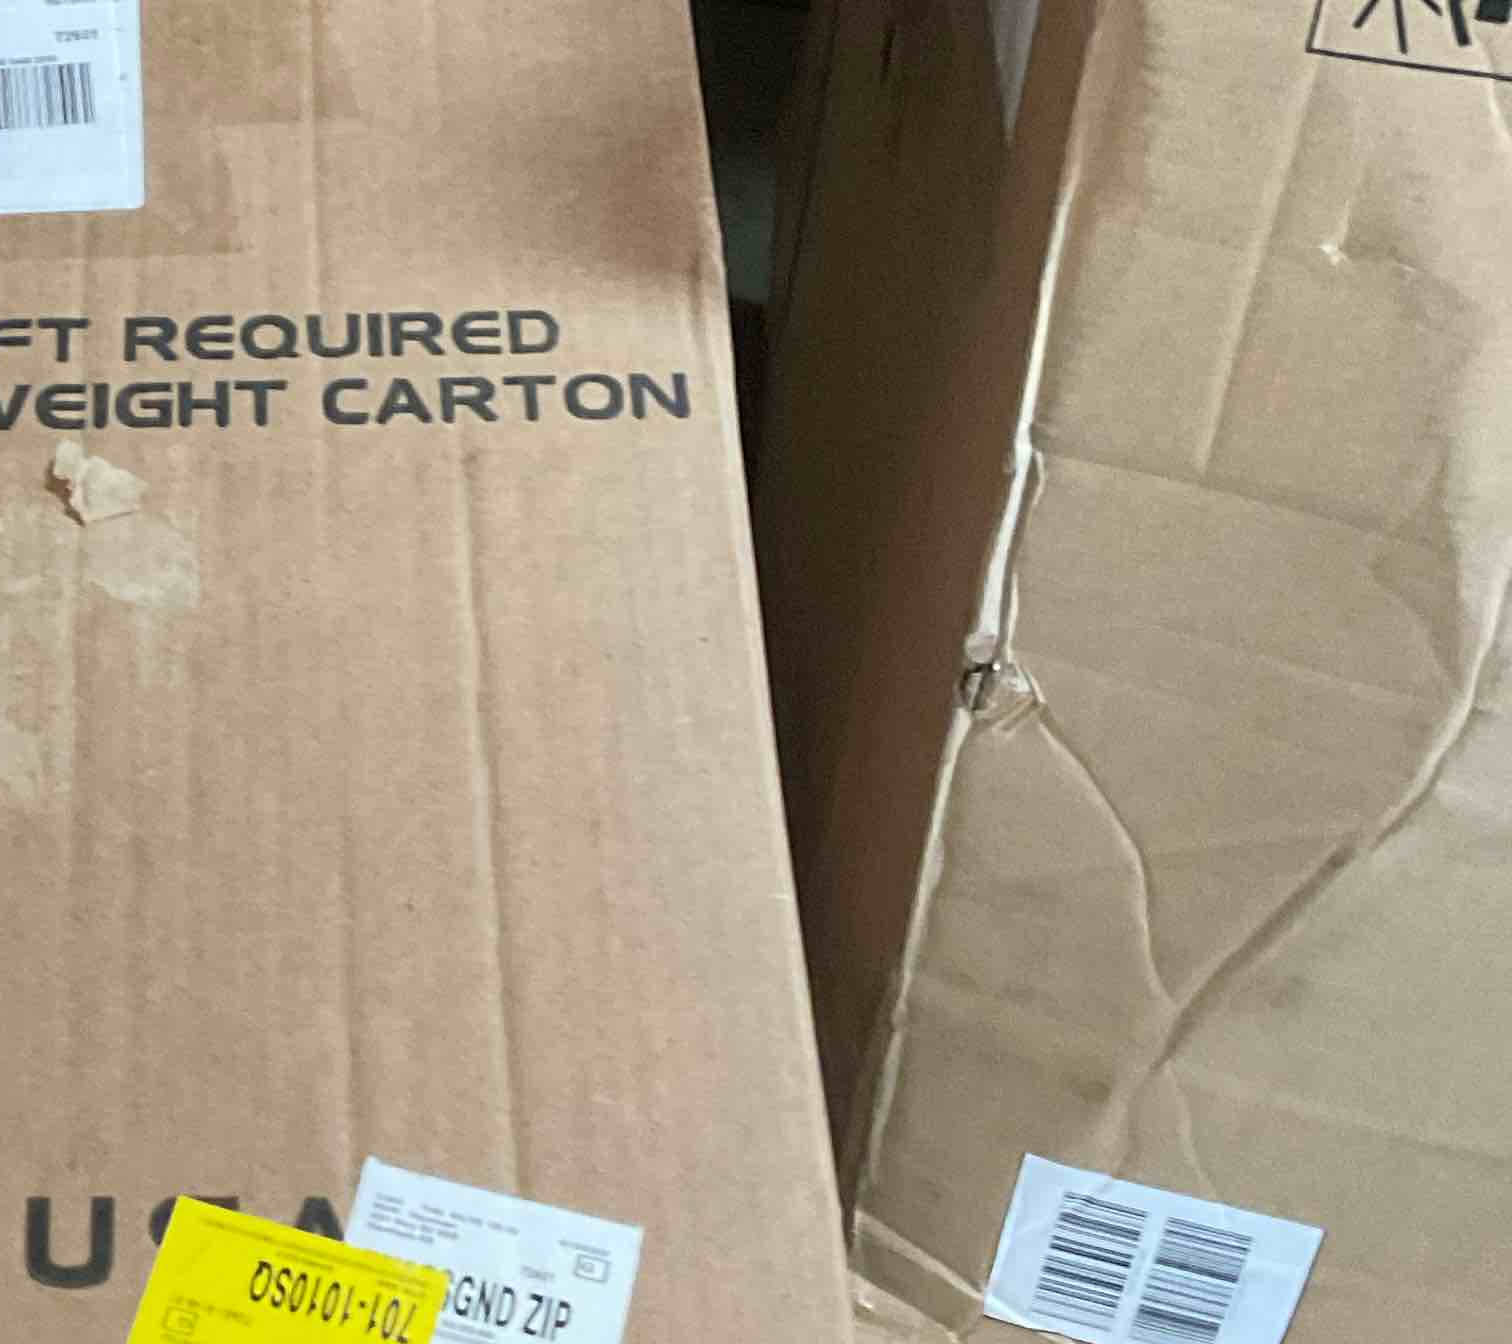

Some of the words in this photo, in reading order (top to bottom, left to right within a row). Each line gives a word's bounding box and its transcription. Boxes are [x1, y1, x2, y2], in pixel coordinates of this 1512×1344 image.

[123, 309, 561, 362] REQUIRED
[322, 371, 692, 427] CARTON
[523, 1292, 573, 1342] ZIP
